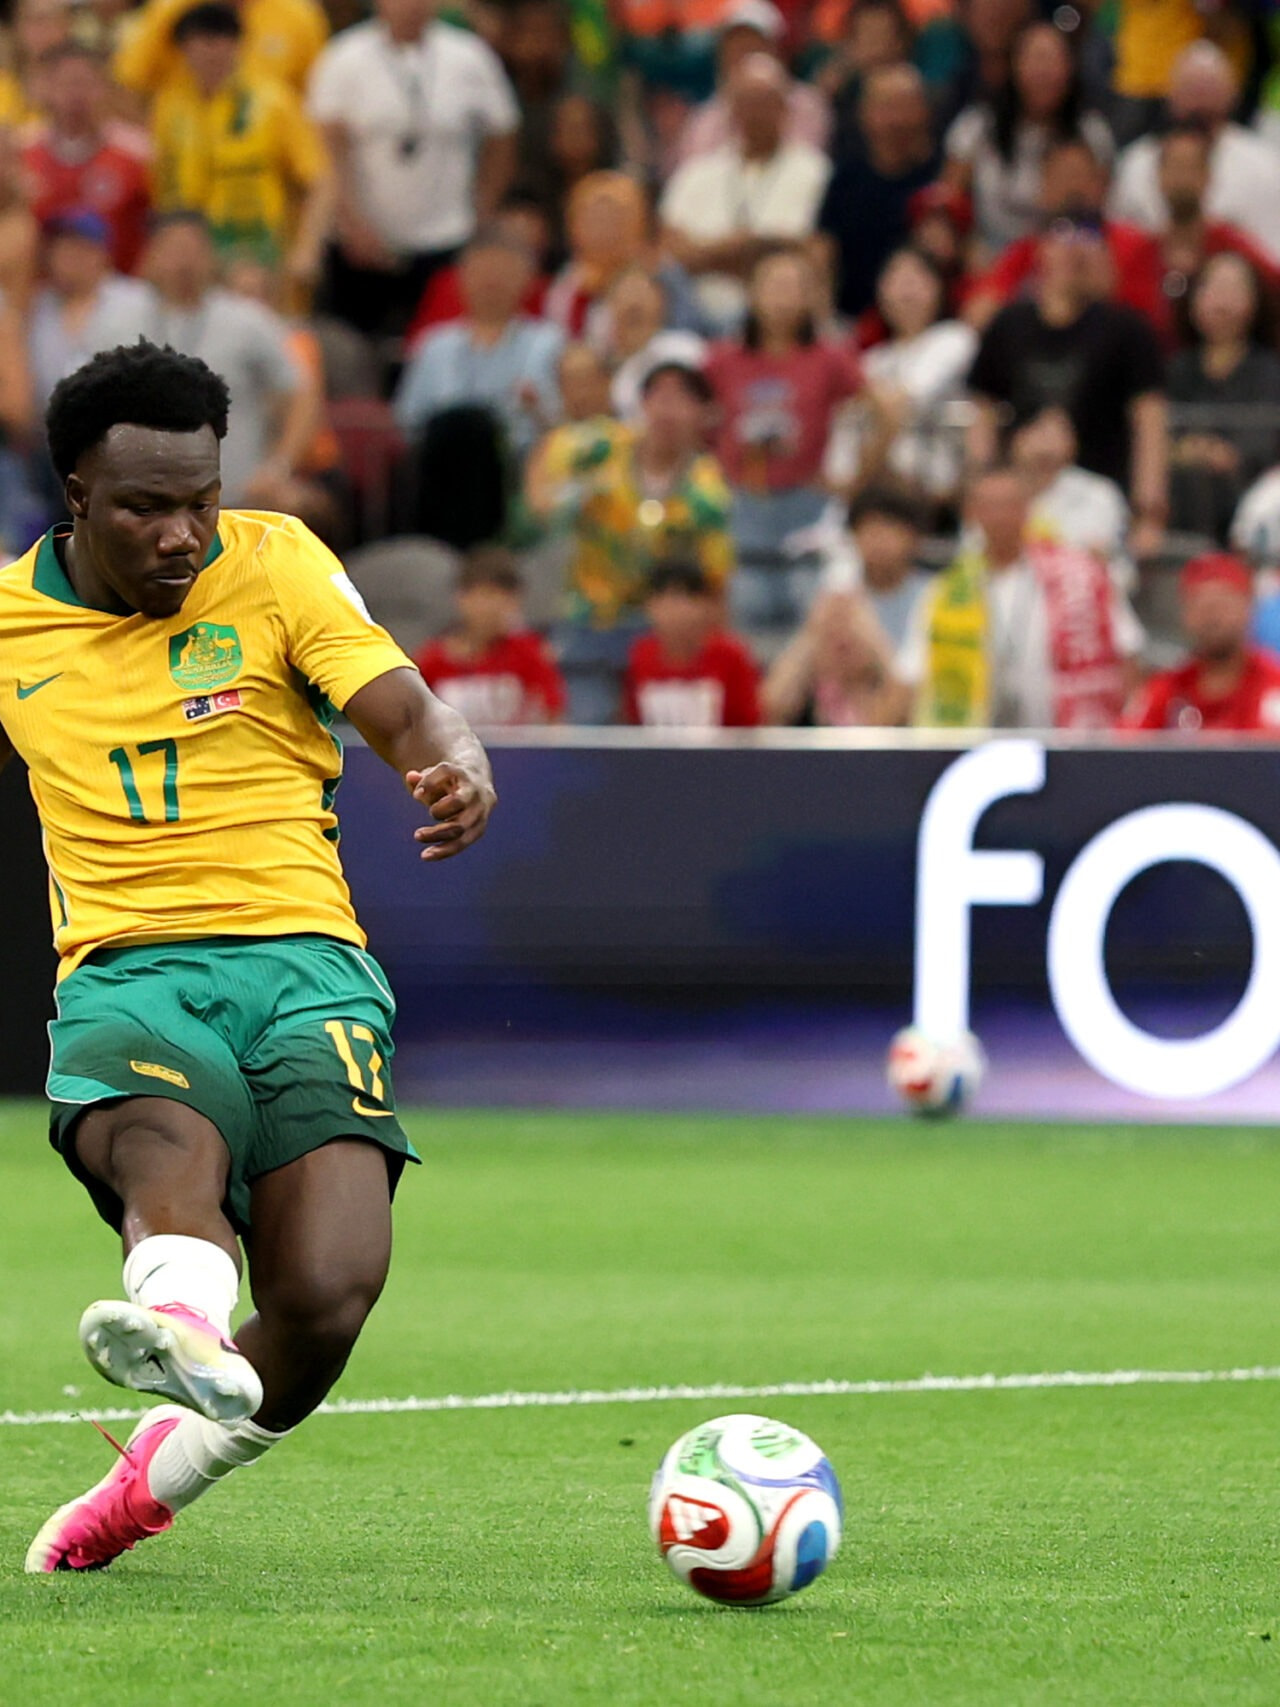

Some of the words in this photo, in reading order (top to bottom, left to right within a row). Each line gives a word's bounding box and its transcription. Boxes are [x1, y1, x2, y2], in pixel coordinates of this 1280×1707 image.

[109, 737, 180, 823] 17
[914, 738, 1280, 1100] fo
[324, 1020, 385, 1102] 17
